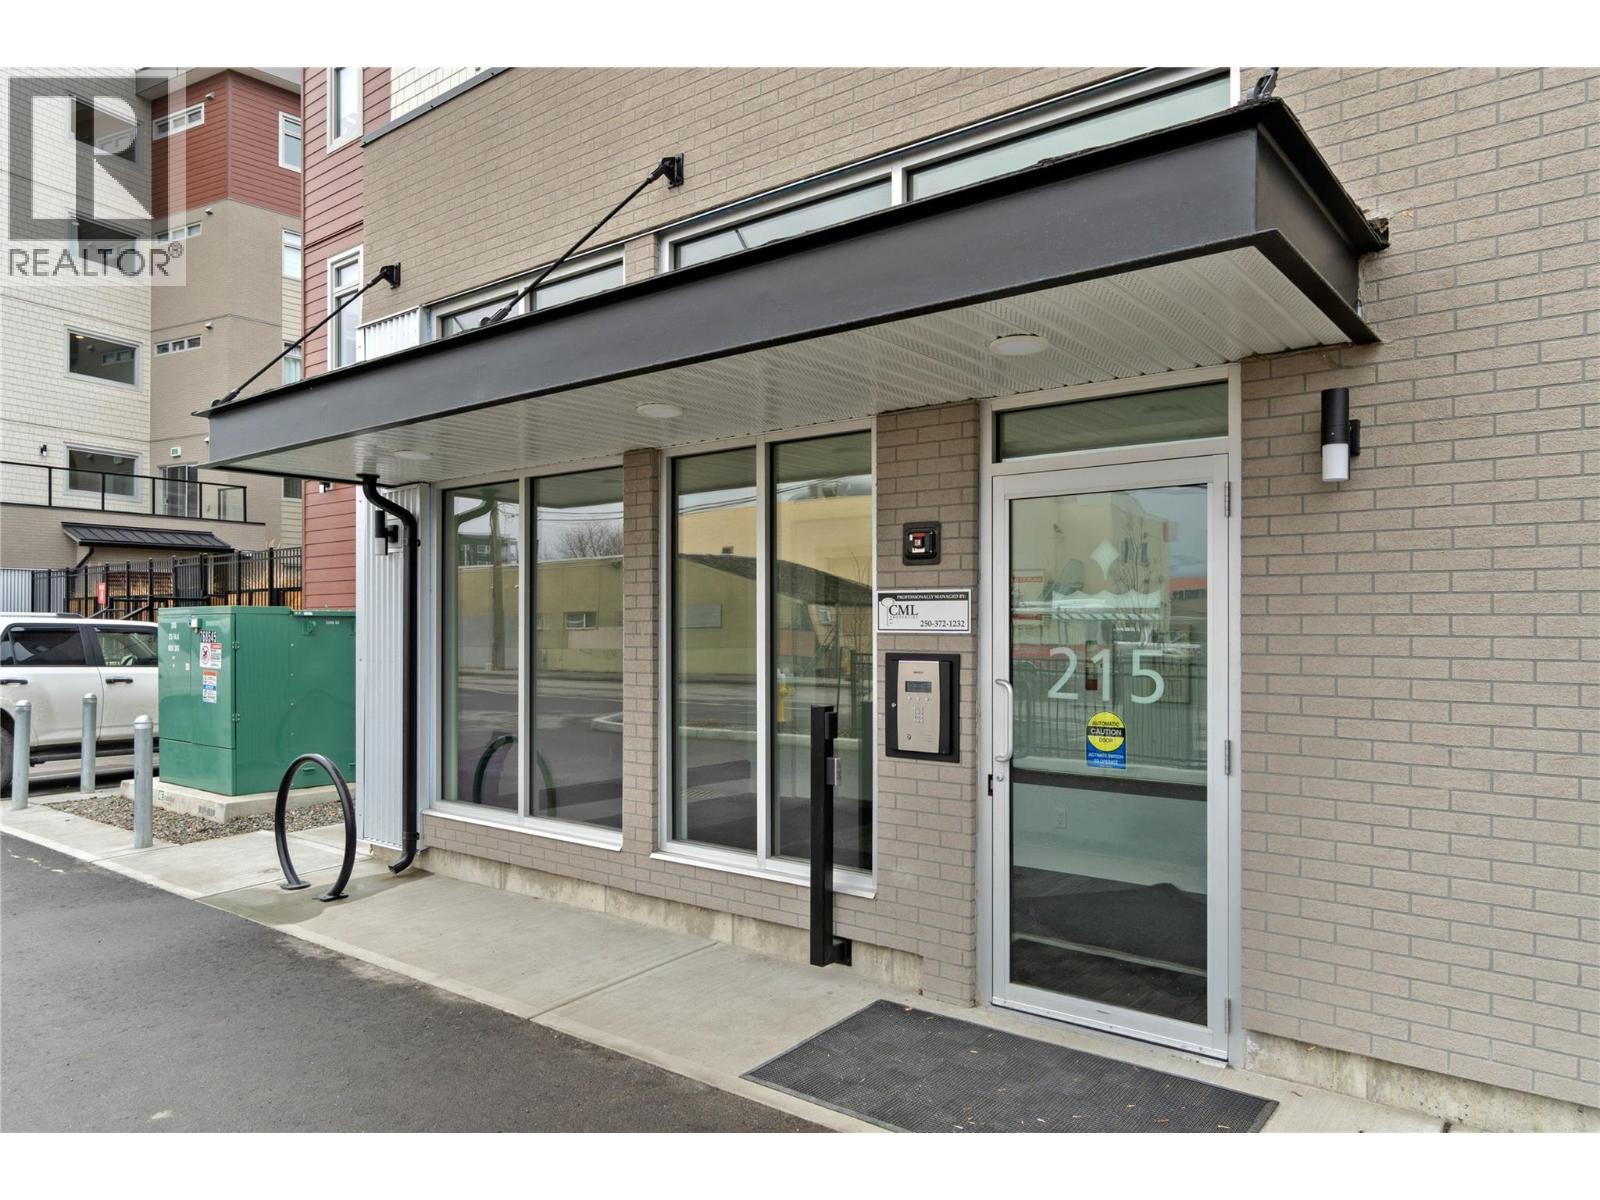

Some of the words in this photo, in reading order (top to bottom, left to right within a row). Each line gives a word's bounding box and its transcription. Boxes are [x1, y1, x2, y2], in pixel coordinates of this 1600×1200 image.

[888, 604, 918, 616] CML
[920, 620, 966, 628] 250-372-1232
[1047, 646, 1165, 704] 215
[1090, 728, 1122, 736] CAUTION
